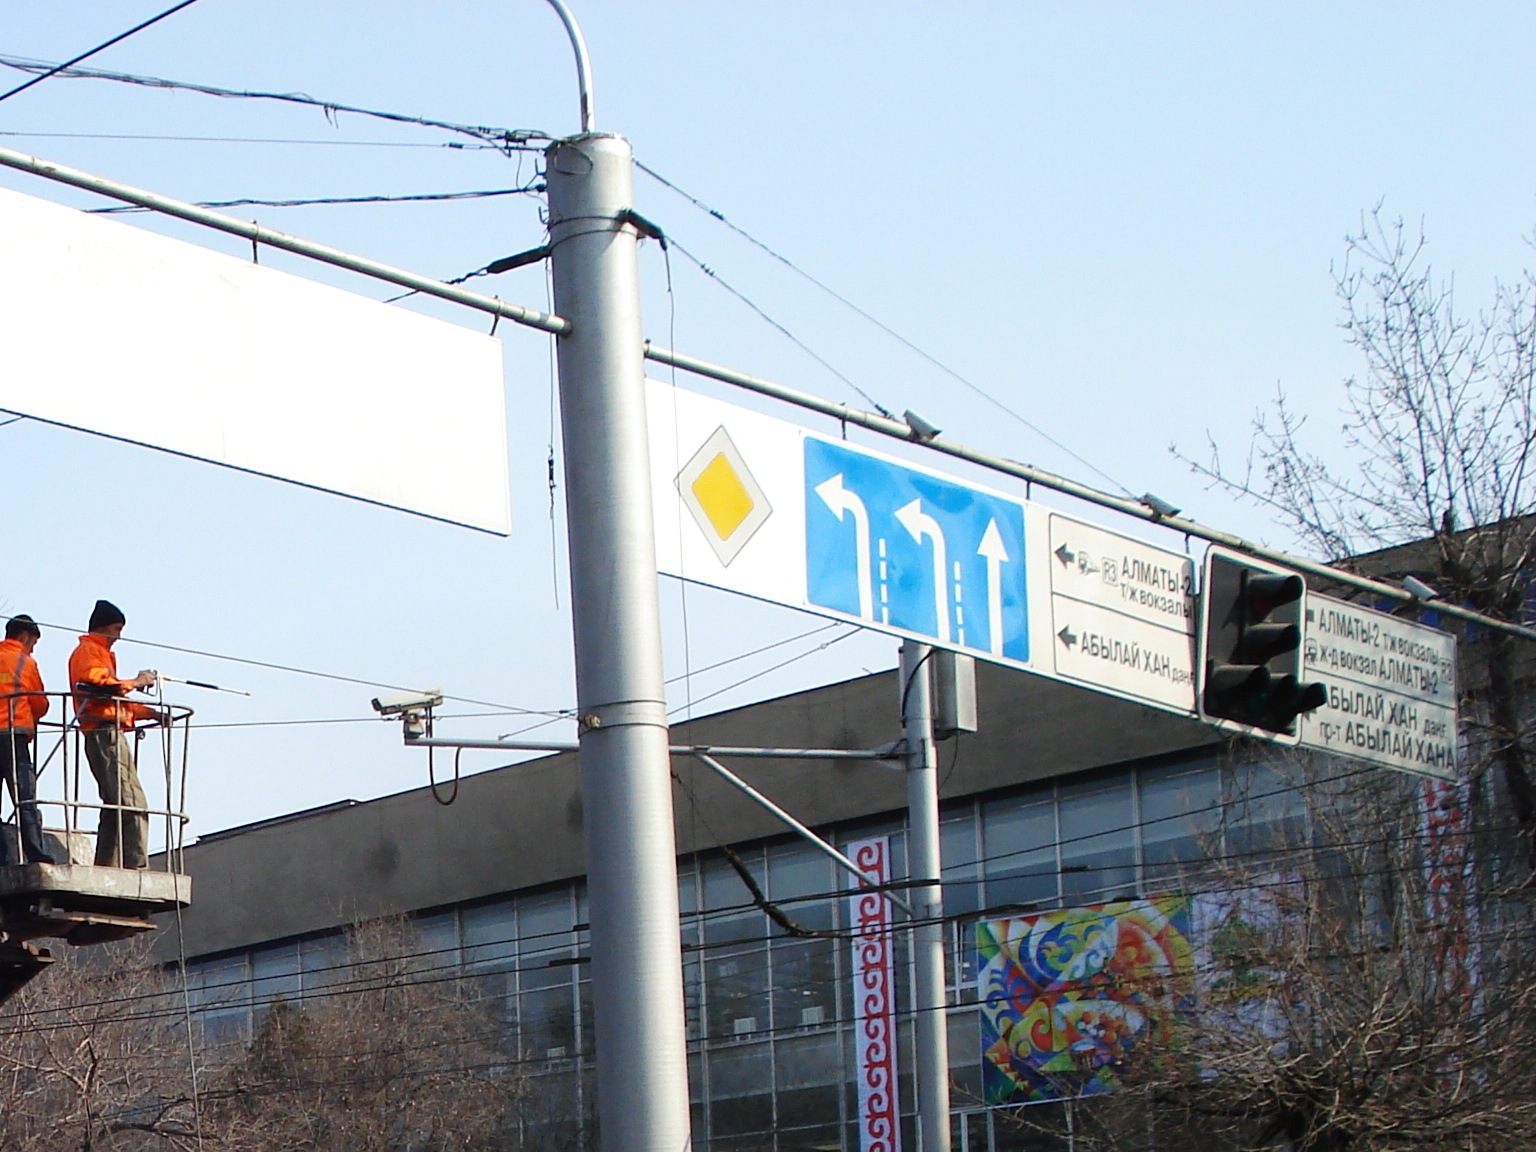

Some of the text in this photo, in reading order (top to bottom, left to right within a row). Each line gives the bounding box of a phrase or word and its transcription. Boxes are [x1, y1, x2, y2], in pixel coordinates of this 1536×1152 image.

[1122, 556, 1192, 597] АЛМАТЫ-2
[1140, 591, 1193, 620] вокзалы
[1319, 607, 1380, 648] АЛМАТЫ-2
[1081, 631, 1141, 670] АБЫЛАЙ
[1144, 650, 1170, 679] ХАН
[1340, 650, 1377, 677] вокзал
[1379, 656, 1439, 695] АЛМАТЫ-2
[1326, 684, 1384, 722] БЫЛАЙ
[1388, 700, 1417, 731] ХАН
[1319, 720, 1455, 771] пр-т АБЫЛАЙ ХАНА
